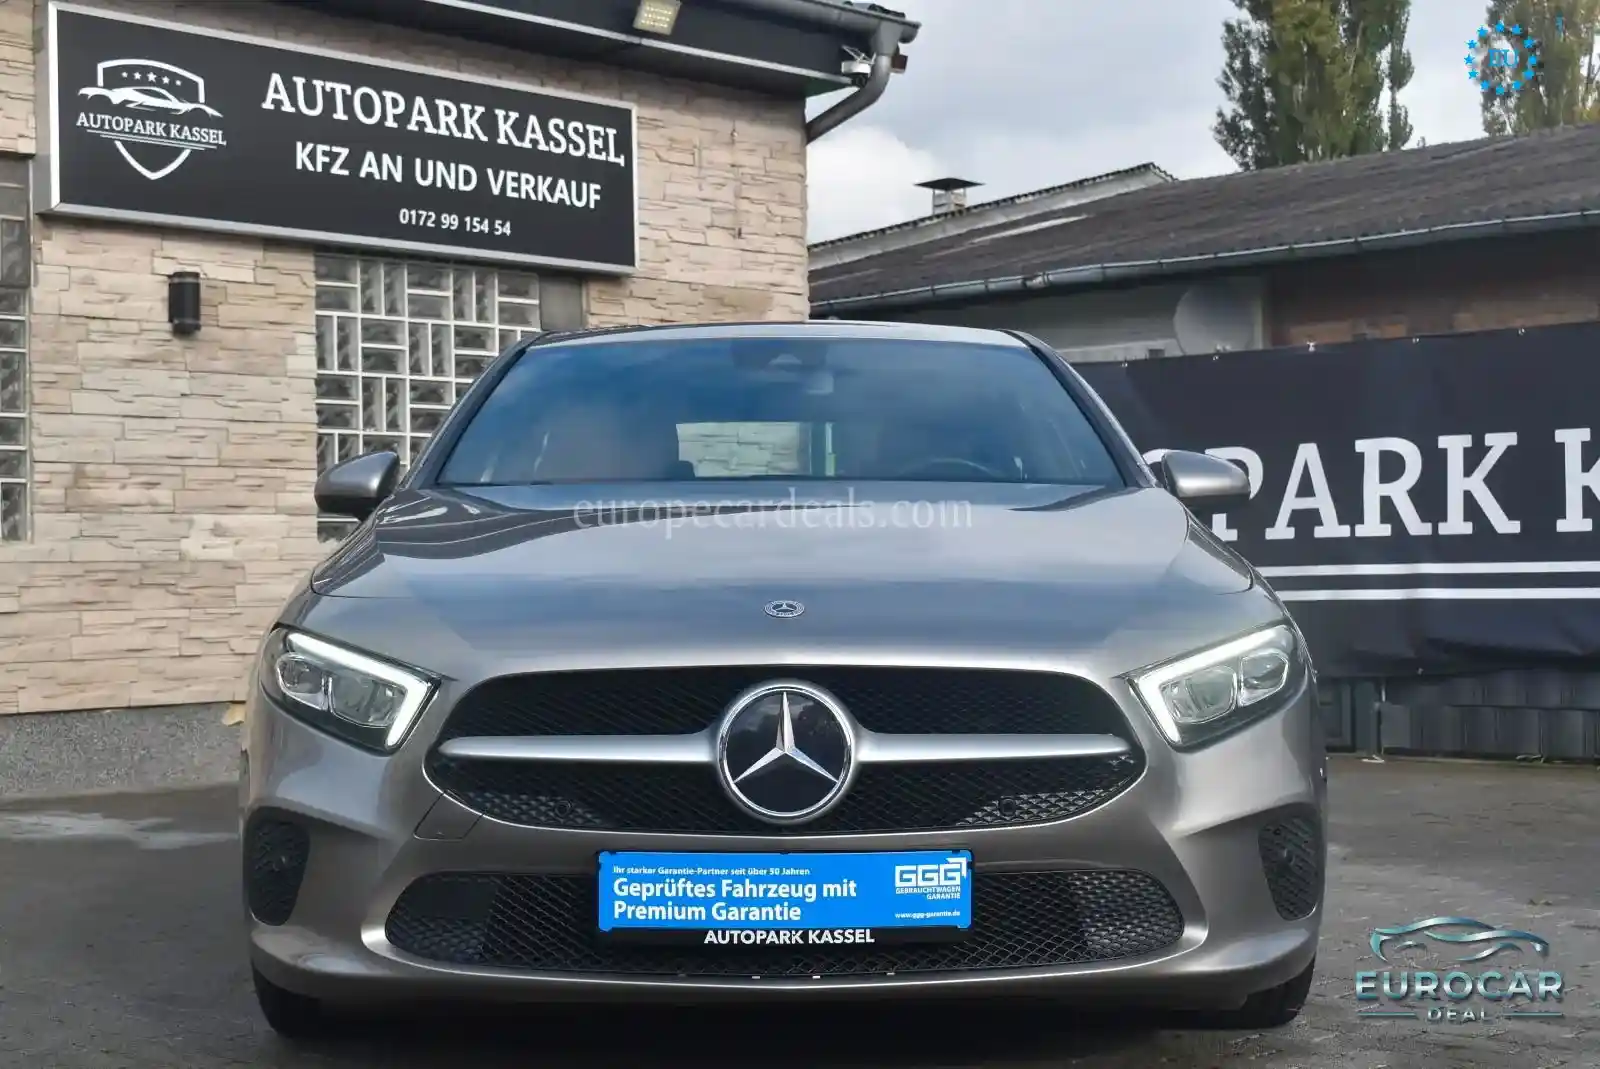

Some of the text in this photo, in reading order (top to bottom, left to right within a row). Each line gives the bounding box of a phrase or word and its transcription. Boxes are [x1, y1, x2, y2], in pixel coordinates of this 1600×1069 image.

[76, 112, 227, 146] AUTOPARK KASSEL
[261, 72, 625, 166] AUTOPARK KASSEL
[295, 141, 602, 209] KFZ AN UND VERKAUF
[399, 208, 512, 237] 0172 99 154 54
[613, 866, 625, 874] Ihr
[658, 866, 728, 876] Garantie-Partner
[730, 867, 746, 876] seit
[748, 867, 767, 876] über
[781, 867, 810, 876] Jahren
[895, 863, 961, 888] GGG
[613, 877, 857, 903] Geprüftes Fahrzeug mit
[895, 886, 961, 895] GEBRAUCHTWAGEN
[613, 901, 802, 921] Premium Garantie
[704, 929, 875, 945] AUTOPARK KASSEL
